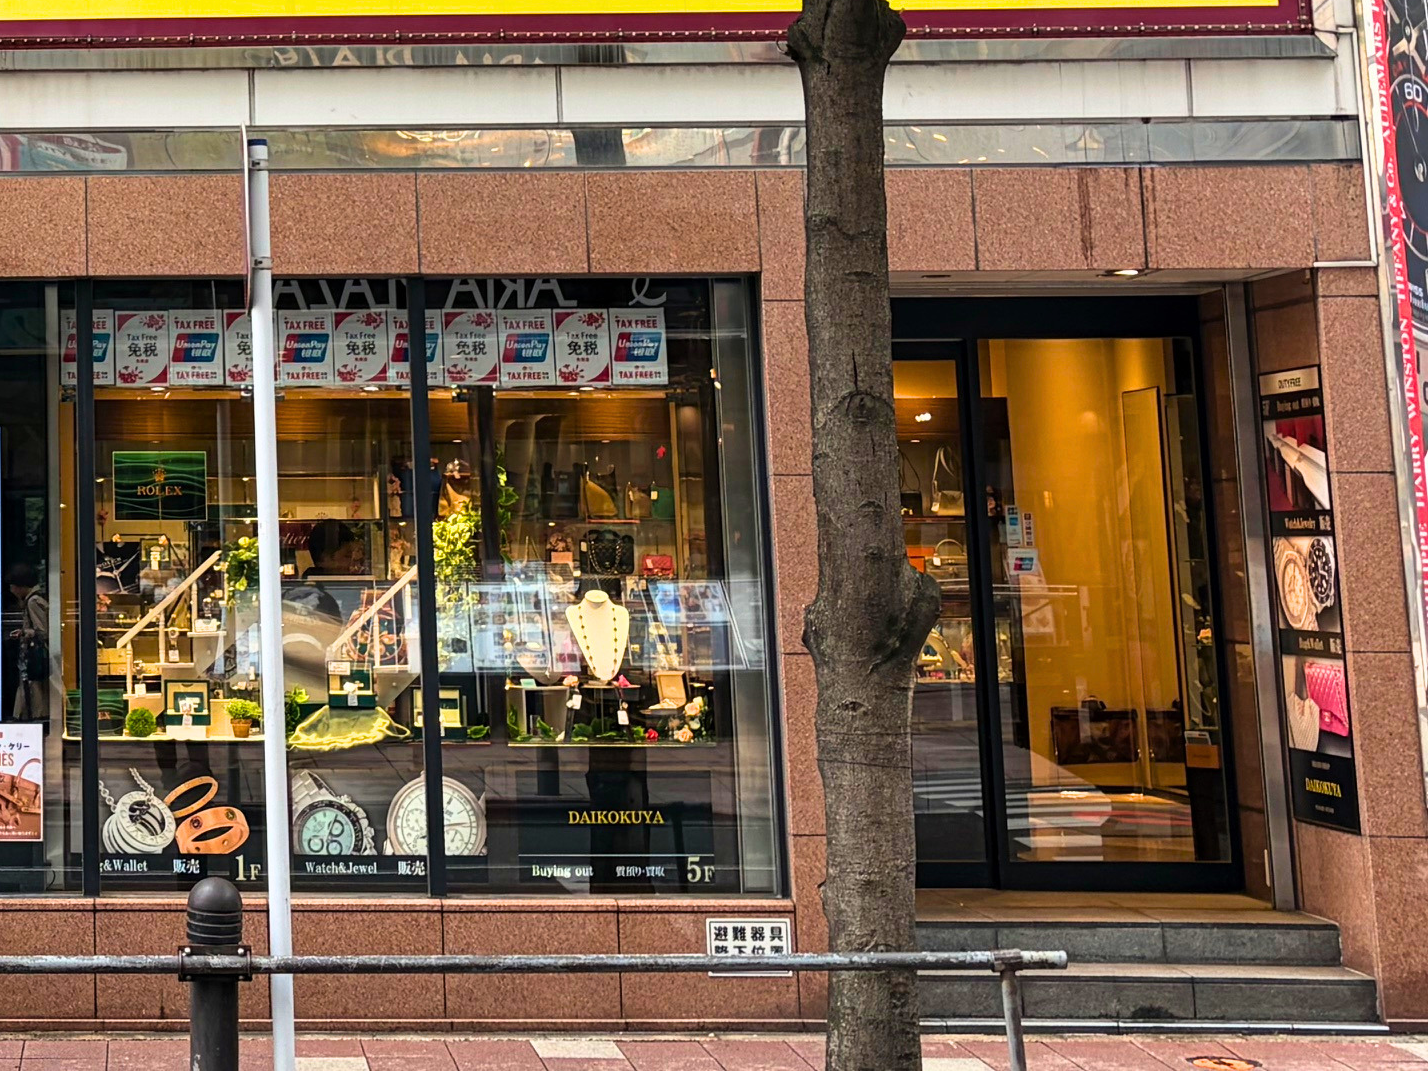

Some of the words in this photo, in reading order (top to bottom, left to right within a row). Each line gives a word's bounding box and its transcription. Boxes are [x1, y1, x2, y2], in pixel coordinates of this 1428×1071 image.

[1373, 21, 1392, 144] AUDEMARS
[1393, 82, 1422, 103] 60
[1388, 215, 1405, 304] TIFFANY
[174, 321, 192, 329] TAX
[193, 321, 215, 329] FREE
[284, 321, 302, 329] TAX
[304, 321, 326, 329] FREE
[503, 320, 520, 330] TAX
[523, 319, 545, 329] FREE
[615, 319, 632, 329] TAX
[634, 319, 658, 329] FREE
[128, 343, 158, 357] 免税
[346, 341, 376, 355] 免税
[455, 341, 487, 355] 免税
[567, 341, 598, 356] 免税
[176, 371, 189, 379] TAX
[191, 371, 209, 379] FREE
[507, 371, 522, 380] TAX
[524, 371, 542, 380] FREE
[1399, 318, 1418, 420] WINSTON
[1410, 432, 1426, 508] HARRY
[137, 486, 183, 496] ROLEX
[568, 810, 665, 825] DAIKOKUYA
[173, 859, 200, 874] 販売
[234, 854, 261, 881] 1F
[305, 861, 378, 874] Watch&Jewel
[397, 860, 426, 875] 販売
[532, 864, 571, 878] Buying
[575, 866, 594, 877] out
[687, 856, 715, 883] 5F
[714, 925, 784, 942] 避難器具
